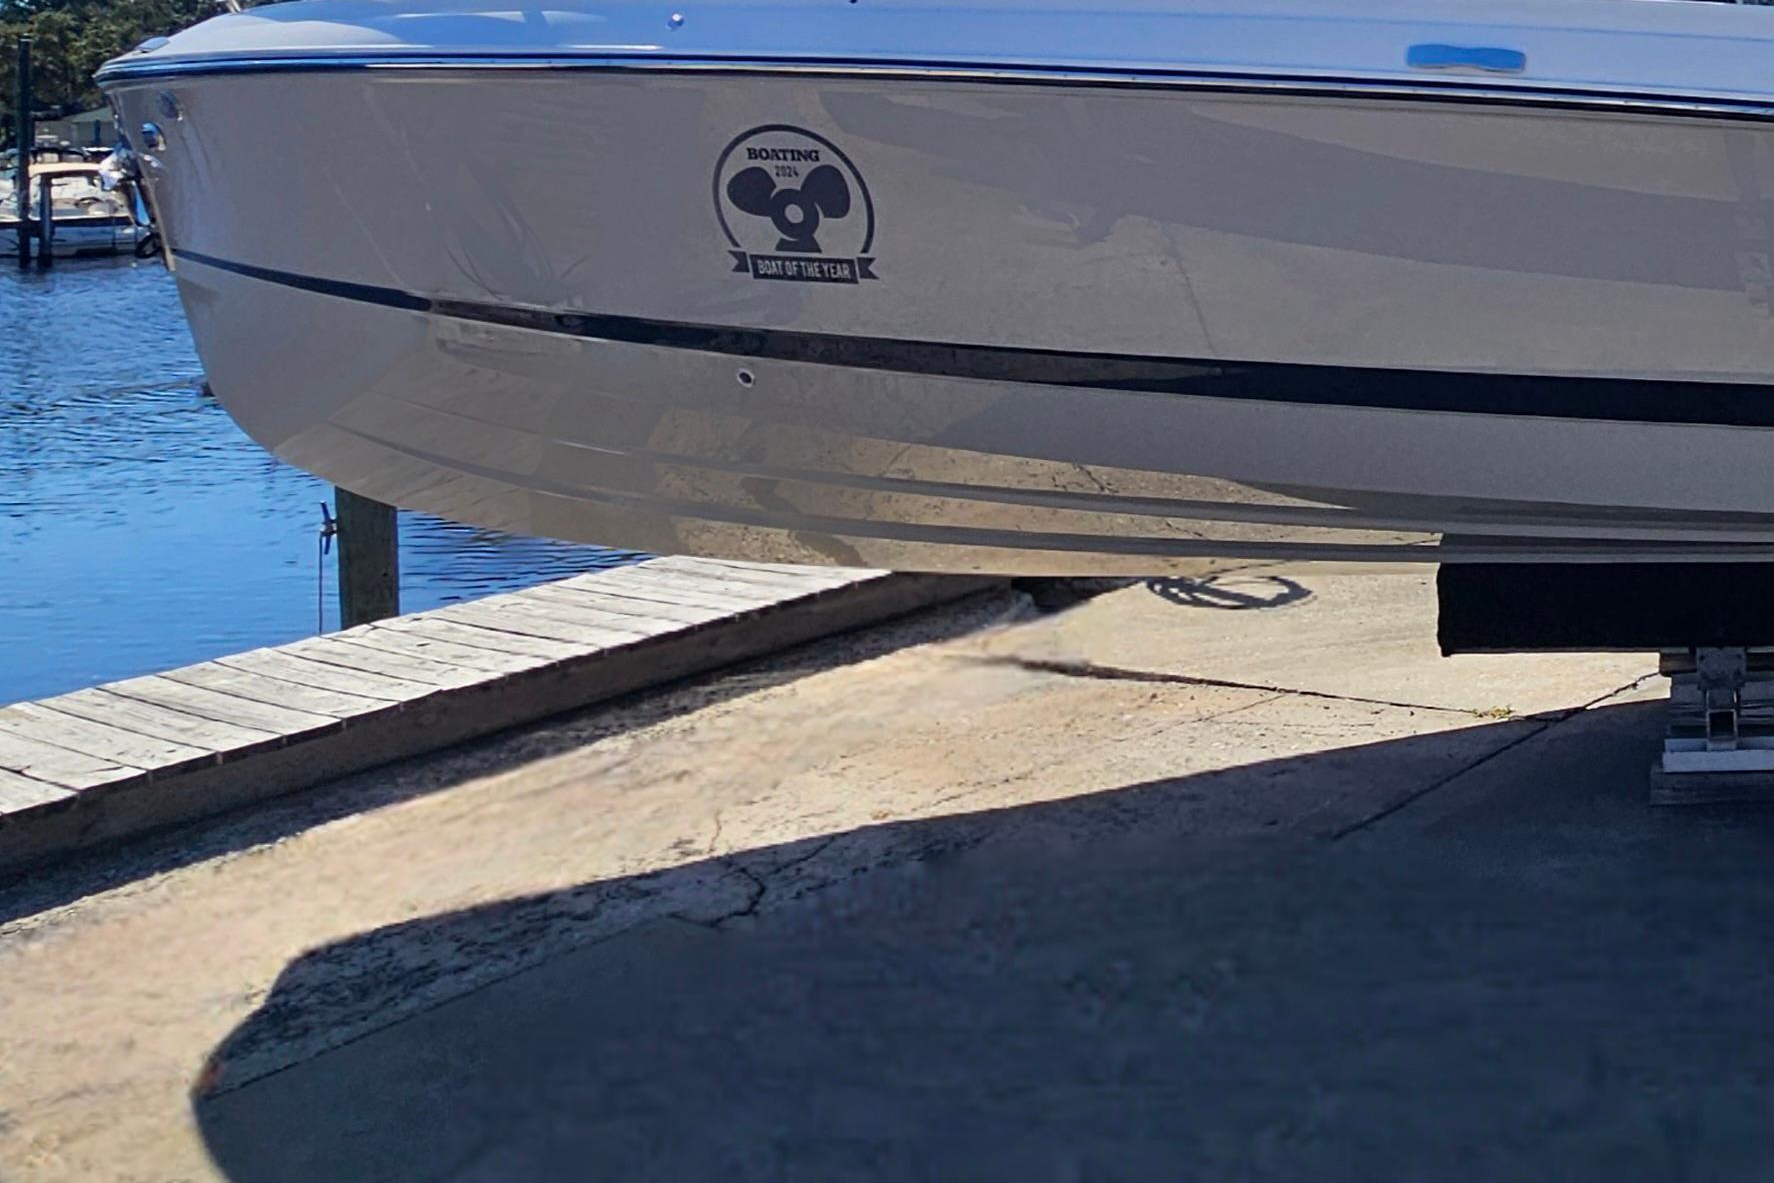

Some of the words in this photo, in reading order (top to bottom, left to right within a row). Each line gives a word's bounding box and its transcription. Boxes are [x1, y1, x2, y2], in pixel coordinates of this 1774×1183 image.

[746, 147, 820, 162] BOATING
[775, 165, 799, 178] 2024
[757, 260, 783, 275] BOAT
[785, 261, 798, 275] OF
[800, 261, 821, 277] THE
[821, 263, 851, 279] YEAR
